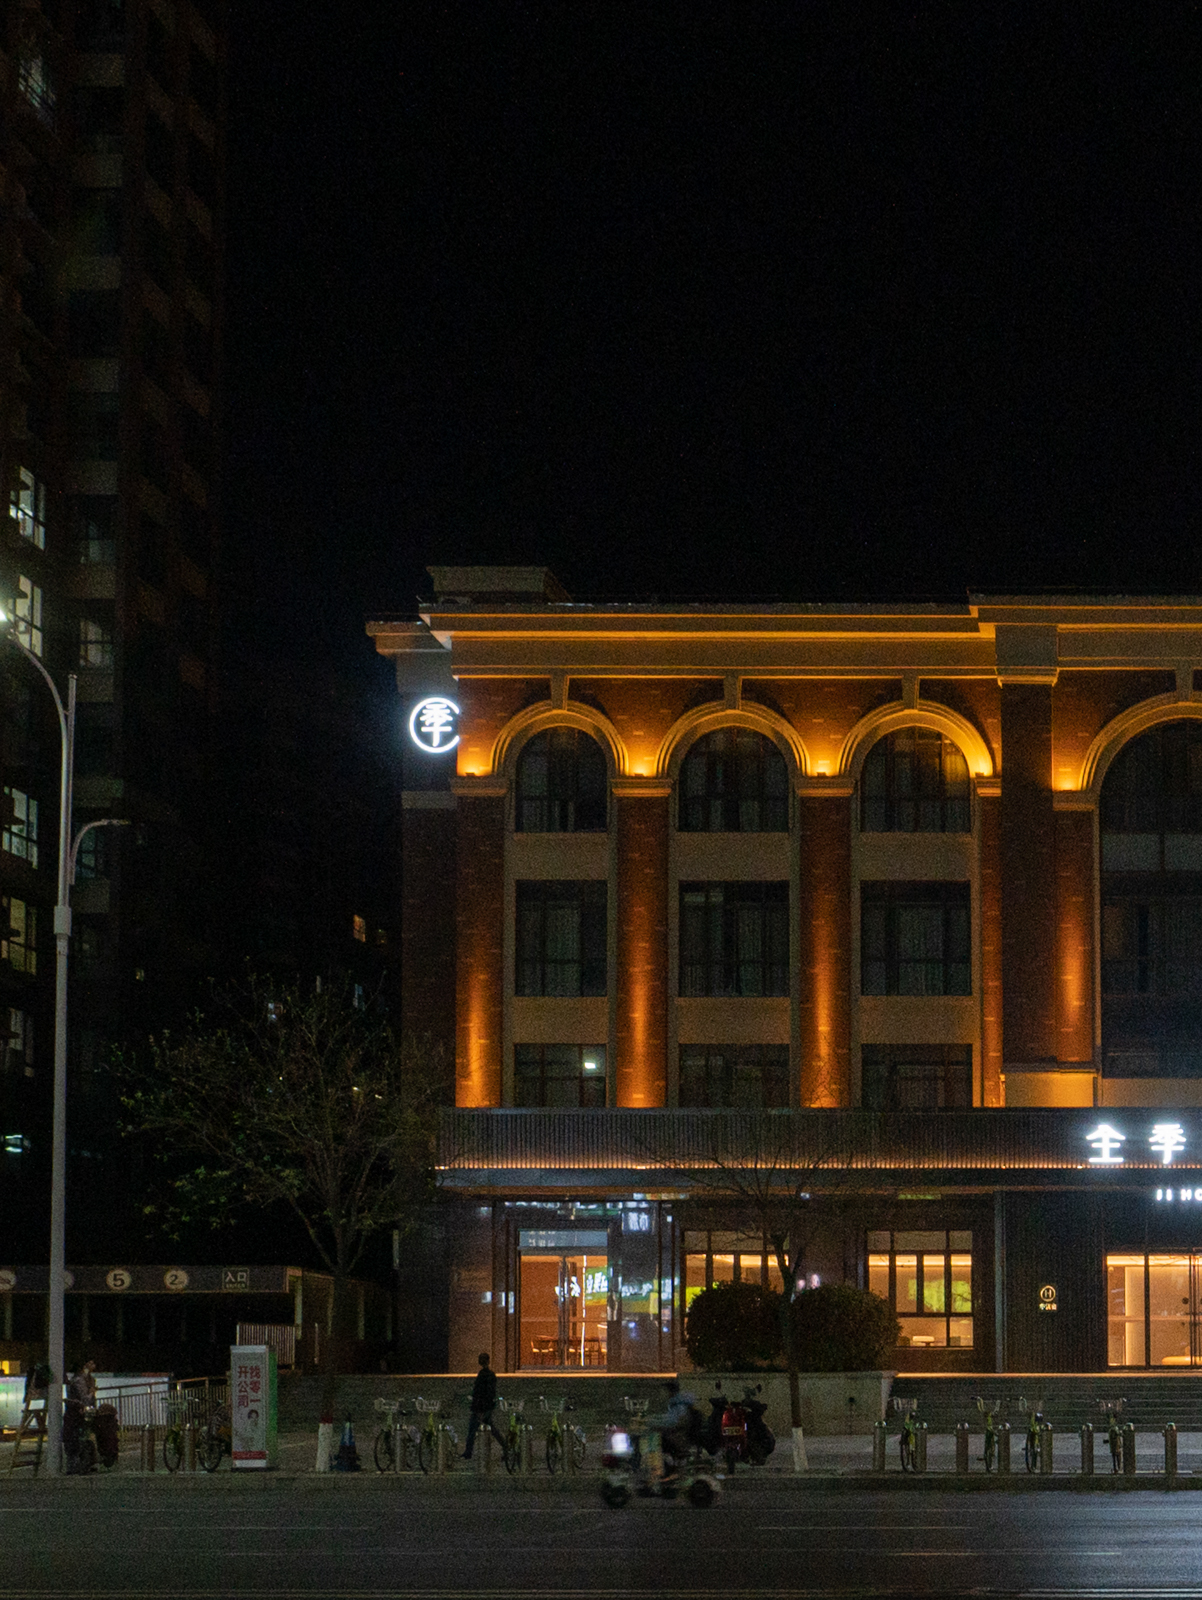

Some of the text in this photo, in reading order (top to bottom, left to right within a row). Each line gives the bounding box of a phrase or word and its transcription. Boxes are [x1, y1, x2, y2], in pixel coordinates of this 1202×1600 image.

[113, 1273, 125, 1287] 5
[225, 1271, 247, 1283] 入口
[237, 1365, 249, 1409] 开公司
